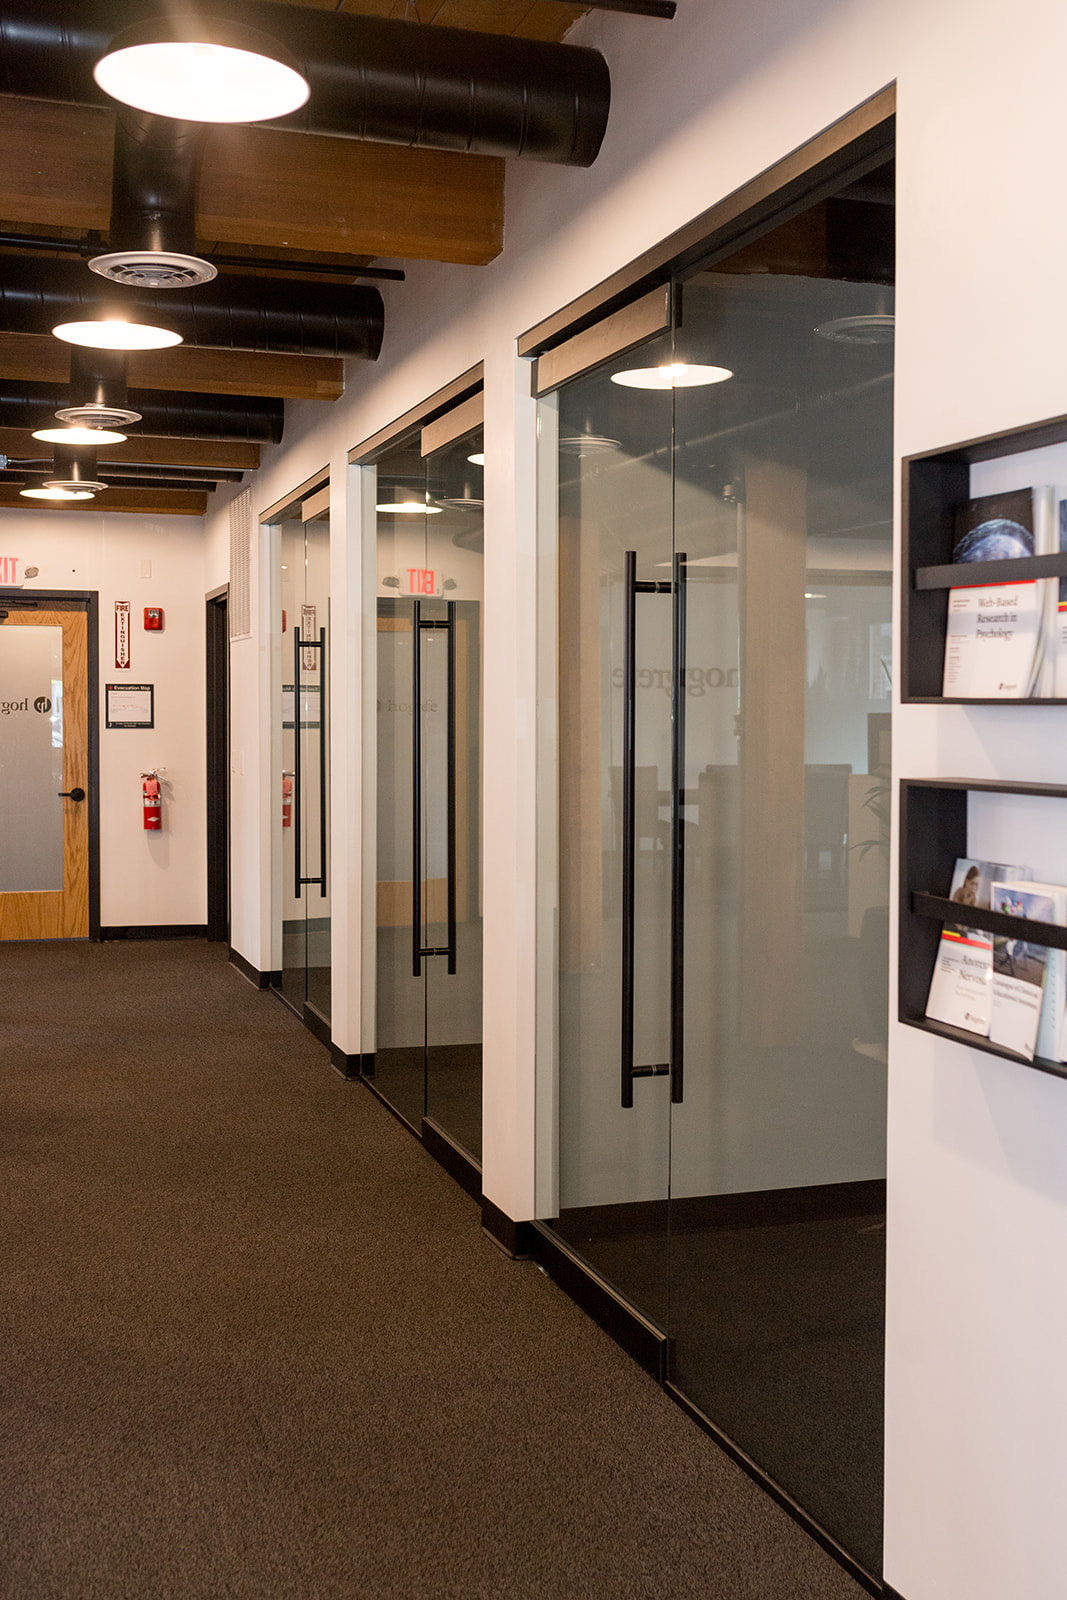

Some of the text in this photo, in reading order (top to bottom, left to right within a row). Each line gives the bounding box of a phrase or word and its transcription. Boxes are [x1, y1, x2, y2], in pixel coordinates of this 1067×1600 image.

[0, 557, 18, 584] IT
[977, 612, 1009, 623] Research
[975, 628, 1014, 642] Psychology
